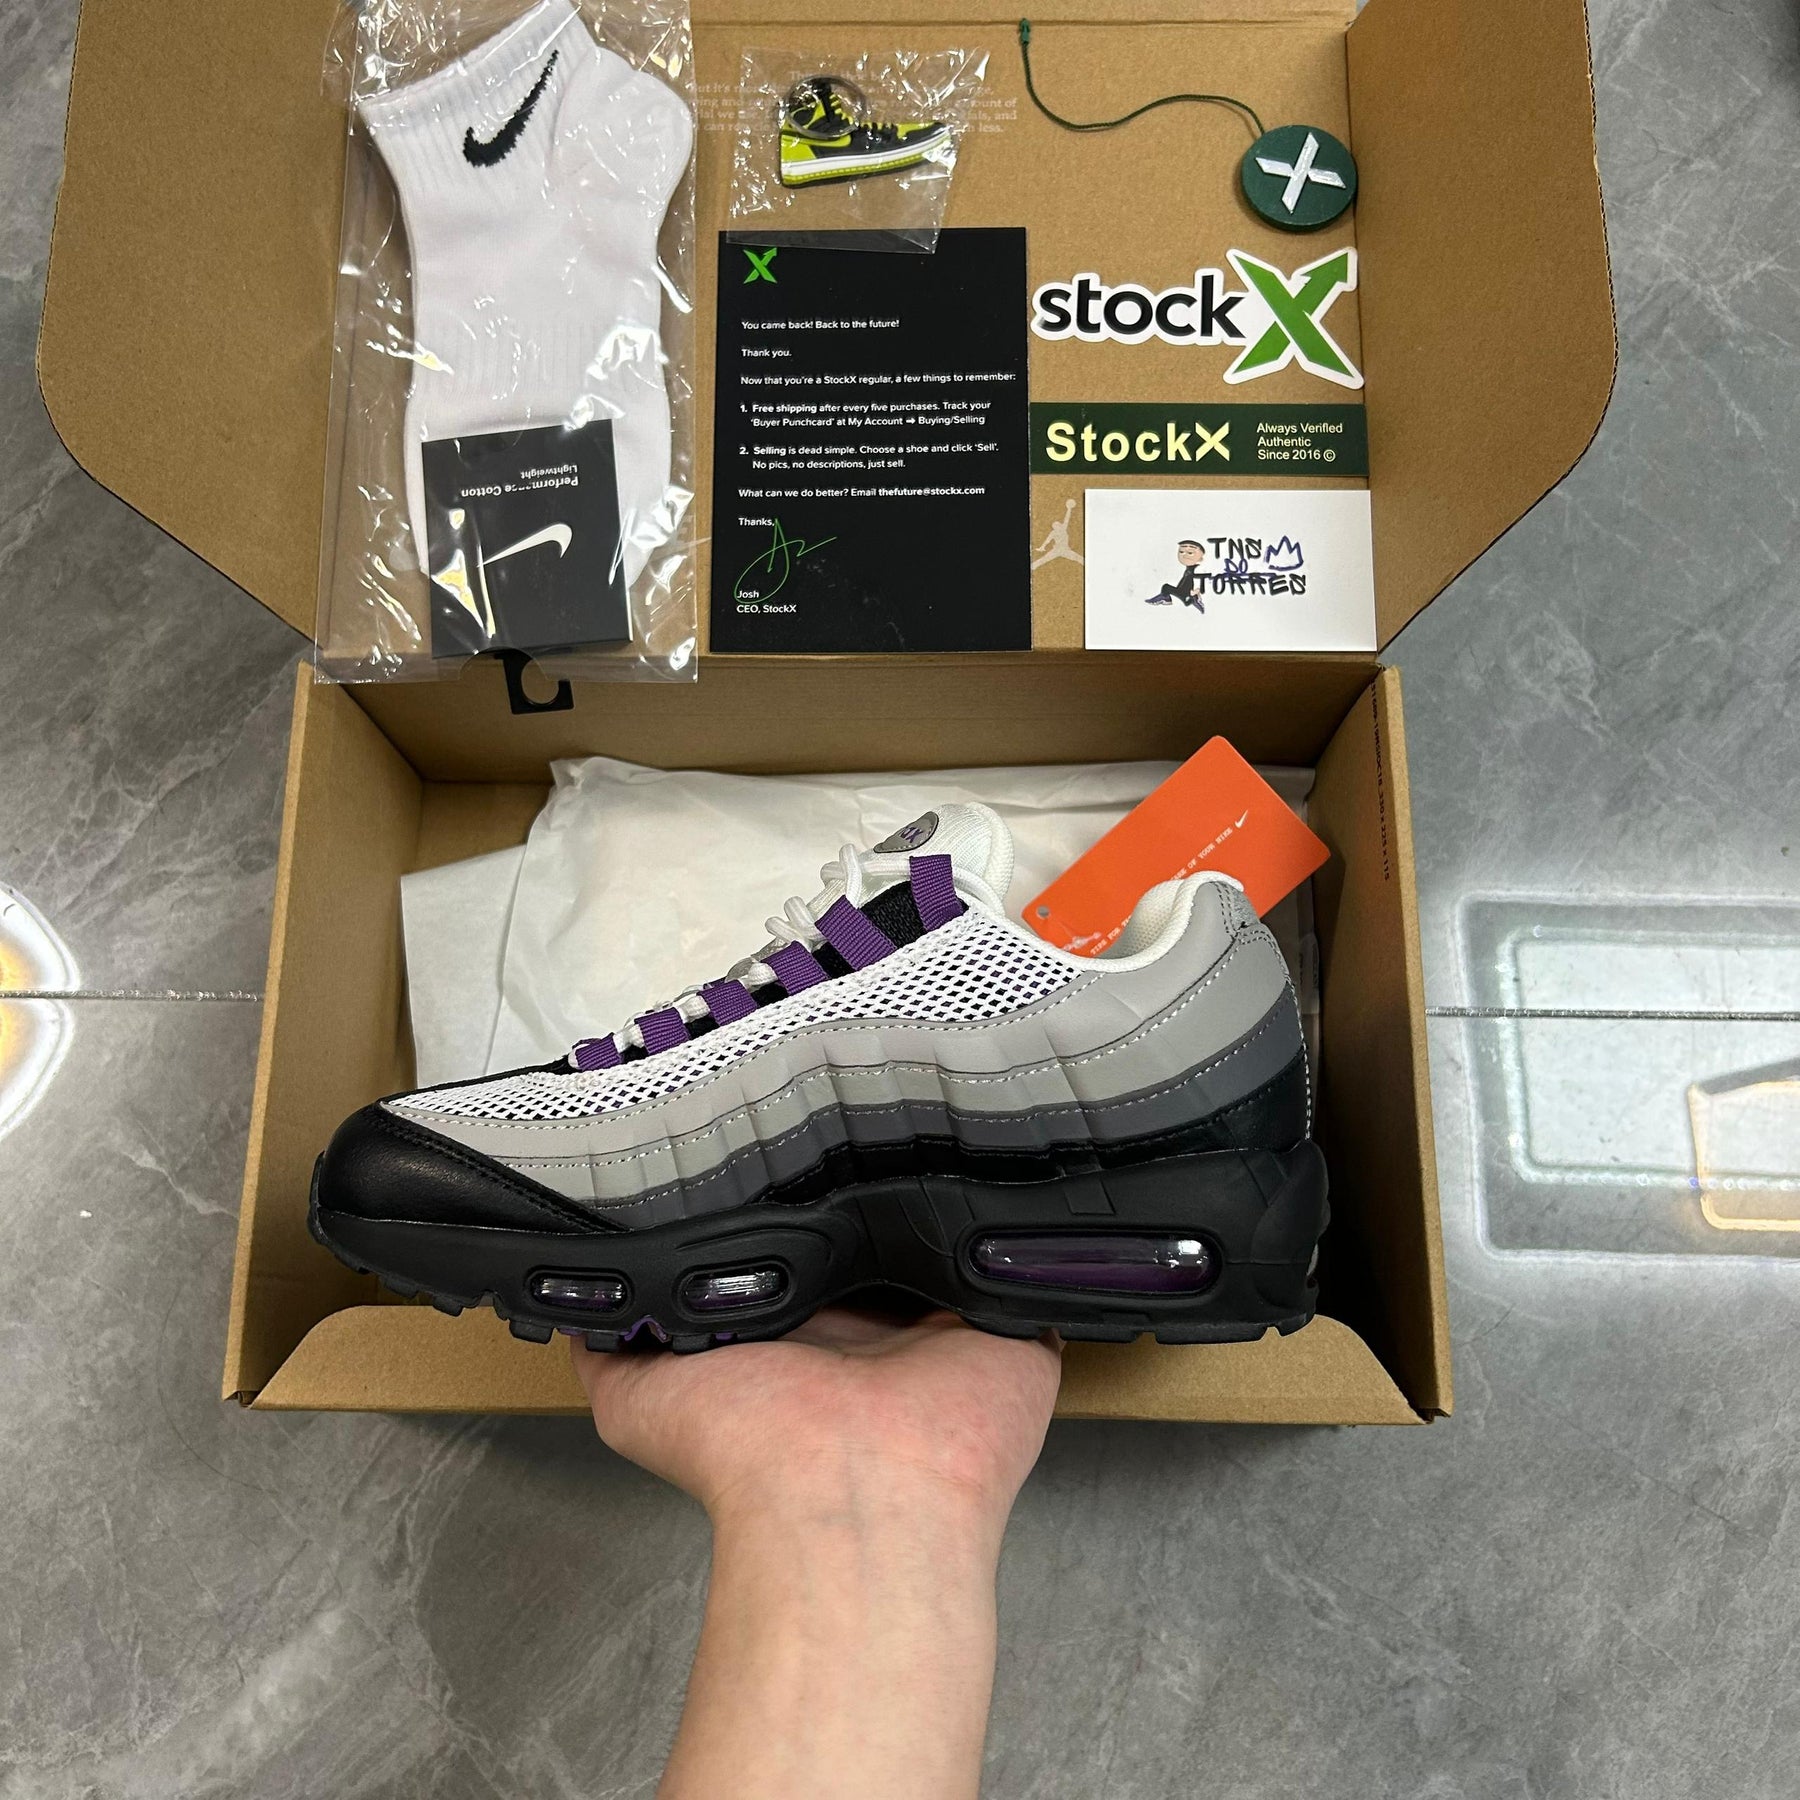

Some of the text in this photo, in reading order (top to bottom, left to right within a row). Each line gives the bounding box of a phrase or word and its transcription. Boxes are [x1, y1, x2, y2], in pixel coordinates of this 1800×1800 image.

[1004, 98, 1018, 107] of
[994, 110, 1018, 119] and
[978, 122, 1005, 132] less.
[1038, 252, 1356, 379] stockX
[741, 319, 900, 330] You came back! Back to the future!
[741, 348, 792, 359] Thank you.
[740, 376, 763, 385] Now
[763, 376, 783, 385] that
[815, 376, 822, 385] a
[823, 375, 857, 385] StockX
[858, 375, 894, 386] regular,
[894, 375, 902, 384] a
[903, 374, 922, 383] few
[922, 373, 952, 384] things
[953, 374, 964, 382] to
[964, 372, 1016, 382] remember:
[739, 401, 992, 414] 1. Free shipping after every five purchases. Track your
[836, 418, 846, 426] at
[847, 417, 863, 428] My
[864, 417, 904, 426] Account
[917, 415, 986, 426] Buying/Selling
[1256, 422, 1344, 434] Always Verified
[1045, 422, 1230, 462] StockX
[1257, 436, 1312, 447] Authentic
[739, 446, 749, 455] 2.
[753, 446, 787, 457] Selling
[788, 446, 797, 455] is
[797, 446, 823, 455] dead
[823, 445, 858, 456] simple.
[859, 445, 896, 454] Choose
[897, 446, 904, 454] a
[905, 444, 930, 454] shoe
[930, 443, 950, 453] and
[950, 443, 973, 453] click
[1257, 449, 1291, 460] Since
[1292, 449, 1321, 460] 2016
[752, 459, 906, 471] No pics, no descriptions, just sell.
[520, 464, 578, 479] Lightweight
[461, 485, 502, 498] Cotton
[738, 486, 985, 498] What can we do better? Email thefuture@stockx.com
[738, 517, 775, 527] Thanks,
[1206, 537, 1262, 560] TNS
[736, 589, 761, 600] Josh
[736, 604, 797, 615] CEO, StockX
[1187, 858, 1198, 869] OF
[1198, 843, 1216, 859] YOUR
[1215, 827, 1233, 844] NIKE
